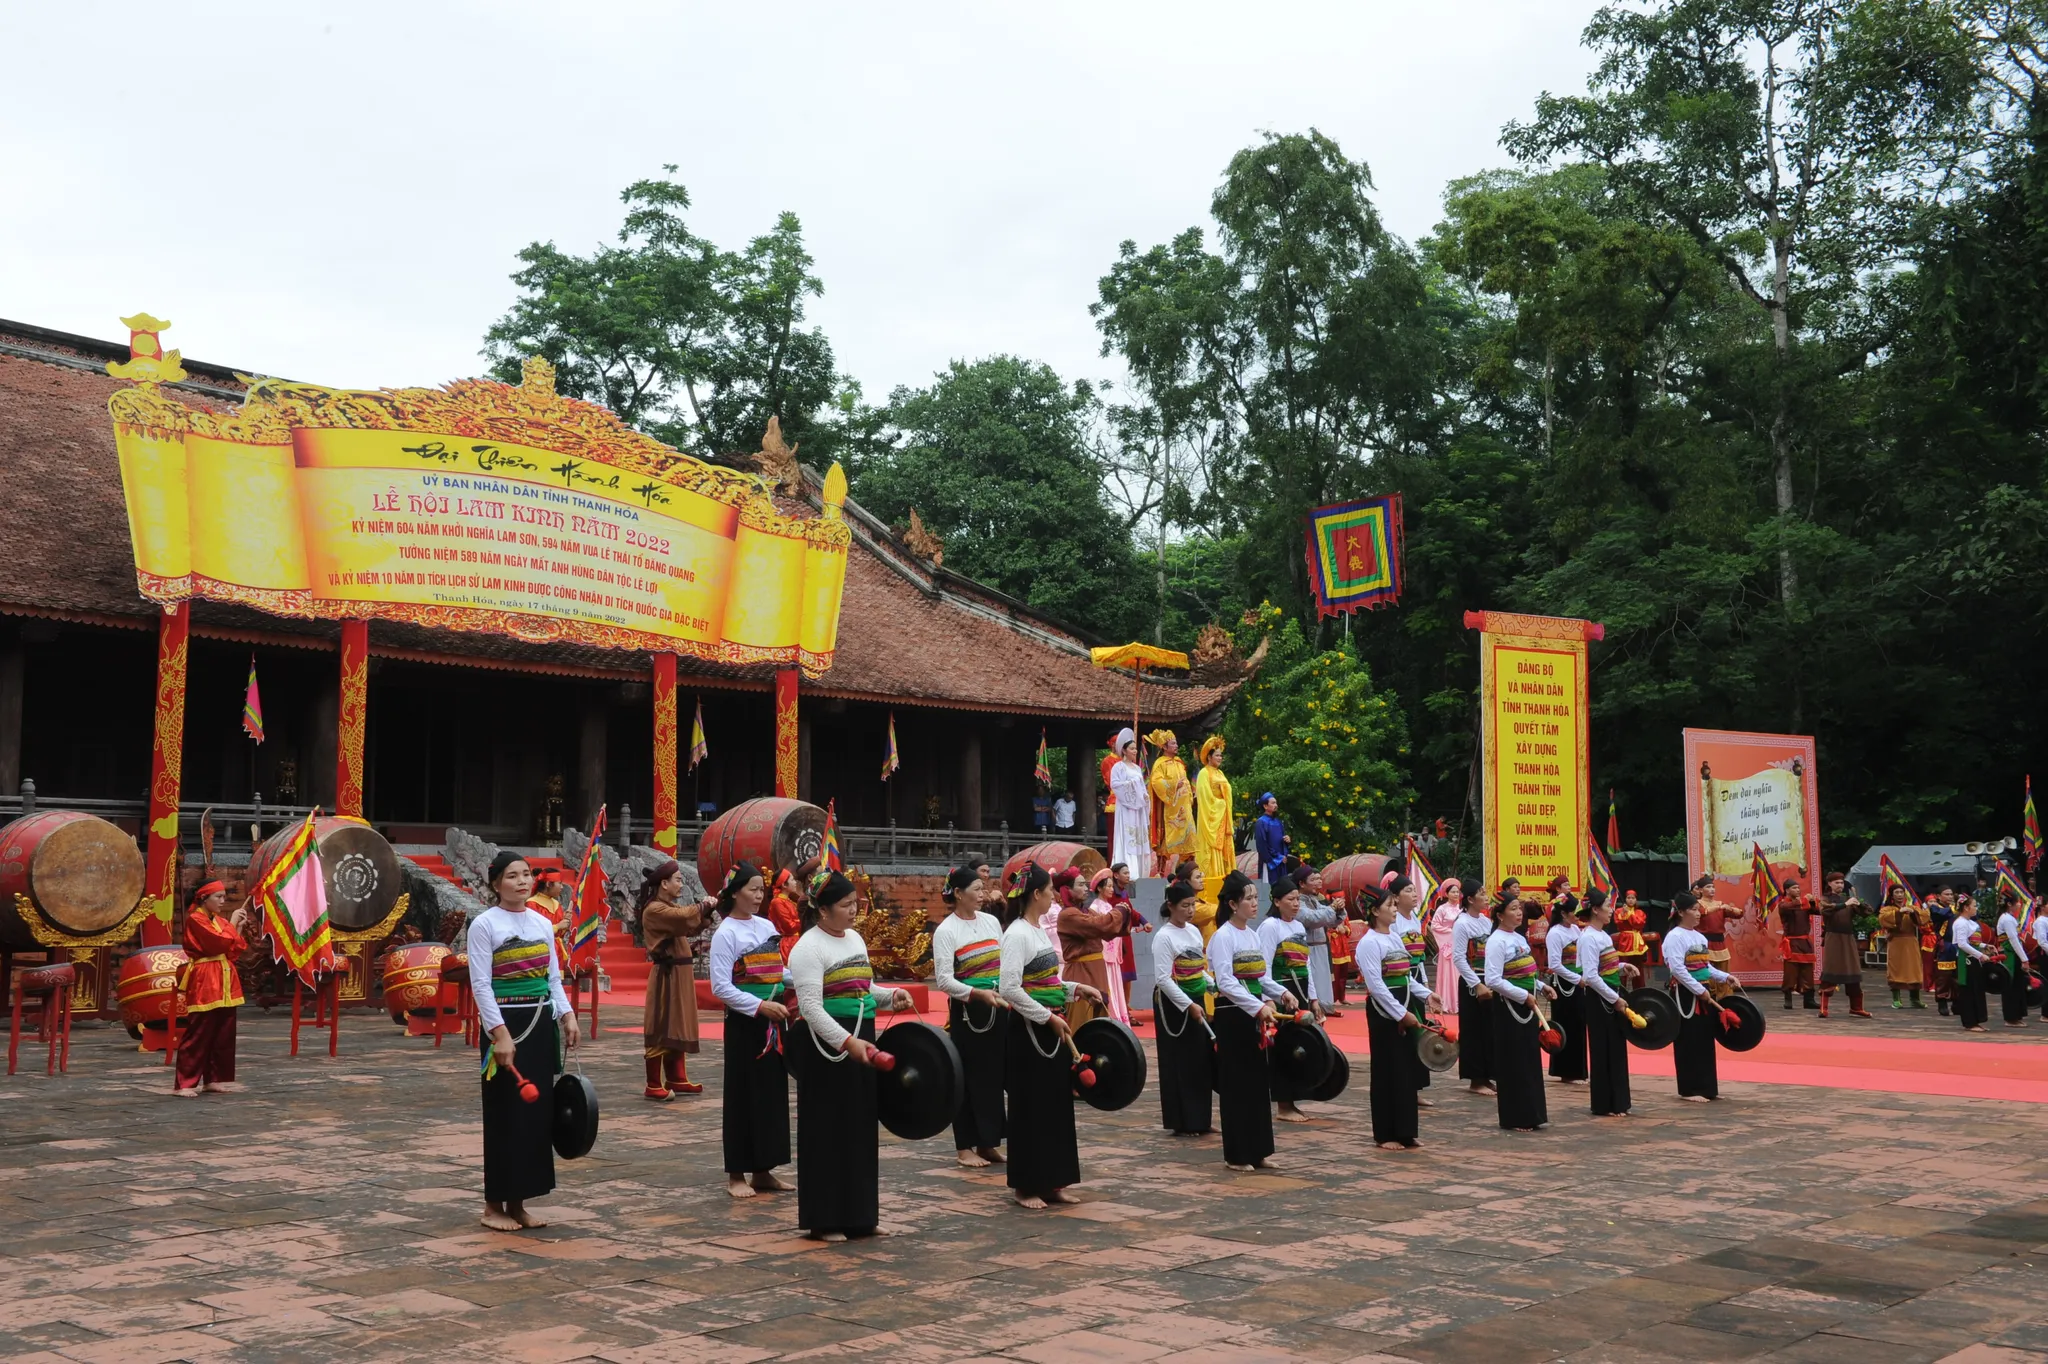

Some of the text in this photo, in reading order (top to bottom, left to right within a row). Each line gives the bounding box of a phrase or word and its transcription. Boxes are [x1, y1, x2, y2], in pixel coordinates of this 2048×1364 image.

[401, 442, 459, 463] Đại
[471, 445, 538, 471] Thiên
[631, 481, 673, 507] Hóa
[443, 477, 469, 489] BAN
[474, 481, 509, 494] NHÂN
[513, 485, 538, 498] DÂN
[543, 489, 569, 504] TỈNH
[572, 496, 611, 513] THANH
[614, 507, 639, 521] HÓA
[372, 485, 670, 555] LỄ HỘI LAM KINH NĂM 2022
[352, 517, 364, 533] KỶ
[368, 519, 394, 536] NIỆM
[397, 522, 414, 534] 604
[417, 521, 439, 536] NĂM
[442, 522, 464, 537] KHỞI
[467, 526, 495, 540] NGHĨA
[497, 530, 517, 543] LAM
[519, 533, 540, 548] SƠN,
[542, 537, 558, 550] 594
[560, 539, 581, 554] NĂM
[583, 544, 599, 557] VUA
[601, 547, 611, 560] LÊ
[613, 550, 631, 566] THÁI
[644, 557, 667, 574] ĐĂNG
[668, 566, 695, 583] QUANG
[399, 543, 658, 596] TƯỞNG NIỆM 589 NĂM NGÀY MẤT ANH HÙNG DÂN TỘC LÊ LỢI
[328, 568, 710, 633] VÀ KỶ NIỆM 10 NĂM DI TÍCH LỊCH SỬ LAM KINH ĐƯỢC CÔNG NHẬN DI TÍCH QUỐC GIA ĐẶC BIỆT
[433, 593, 469, 603] Thanh
[500, 599, 525, 609] ngày
[541, 604, 571, 615] tháng
[581, 610, 602, 619] năm
[605, 613, 626, 624] 2022
[1517, 658, 1554, 679] ĐẢNG BỘ
[1508, 679, 1564, 697] VÀ NHÂN DÂN
[1502, 697, 1570, 717] TỈNH THANH HÓA
[1513, 720, 1559, 736] QUYẾT TÂM
[1516, 740, 1557, 759] XÂY DỰNG
[1513, 762, 1560, 777] THANH HÓA
[1512, 780, 1561, 796] THÀNH TỈNH
[1740, 786, 1752, 801] đại
[1753, 783, 1772, 798] nghĩa
[1518, 801, 1557, 819] GIÀU ĐẸP,
[1740, 804, 1760, 819] thắng
[1762, 803, 1779, 815] hung
[1515, 821, 1560, 838] VĂN MINH,
[1722, 828, 1739, 844] Lấy
[1752, 825, 1769, 837] nhân
[1520, 841, 1556, 860] HIỆN ĐẠI
[1742, 848, 1754, 860] tha
[1780, 841, 1793, 855] bạo
[1506, 861, 1570, 877] VÀO NĂM 2030!
